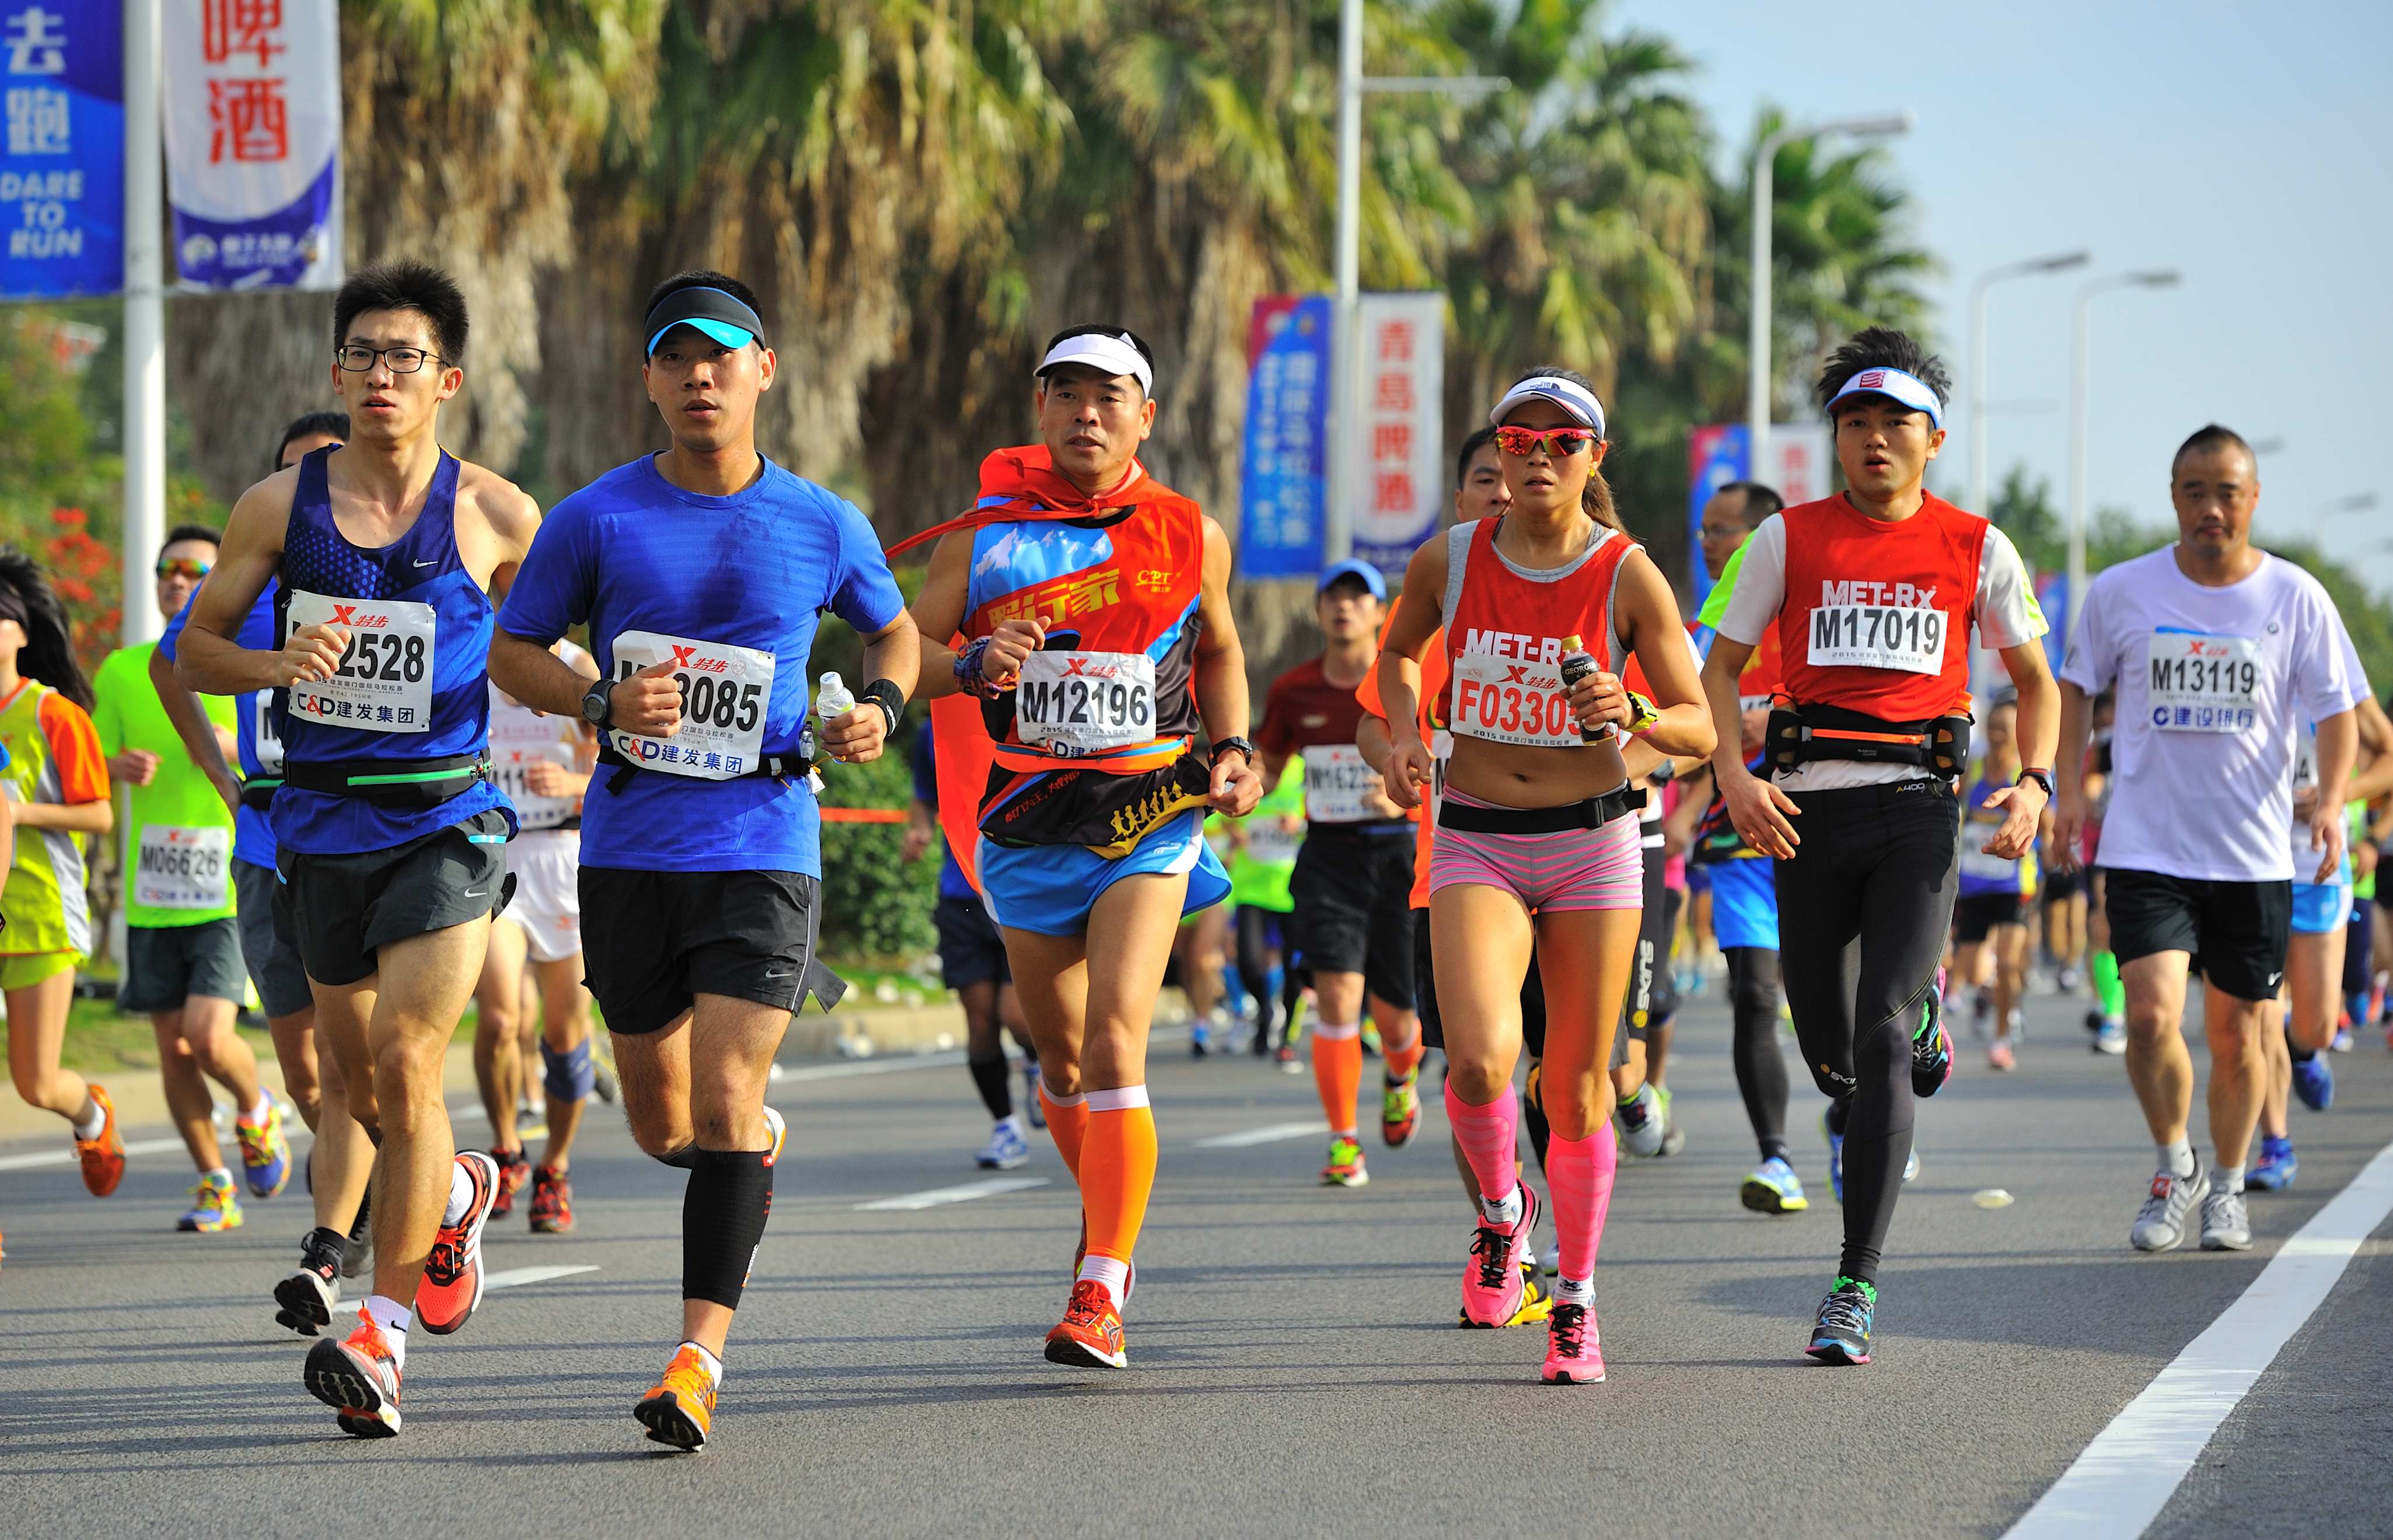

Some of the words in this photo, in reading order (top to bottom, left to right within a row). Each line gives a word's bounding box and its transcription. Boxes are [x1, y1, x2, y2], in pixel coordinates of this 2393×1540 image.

[5, 7, 69, 154] 去跑
[0, 171, 83, 200] DARE
[21, 204, 65, 226] TO
[9, 232, 82, 258] RUN
[1137, 569, 1173, 584] CPT
[1465, 628, 1563, 666] MET-R
[1816, 608, 1940, 655] M17019
[293, 621, 424, 682] 2528
[2153, 658, 2255, 693] M13119
[621, 660, 762, 732] 8085
[1022, 681, 1148, 726] M12196
[682, 725, 733, 740] 门国际马拉松赛
[1473, 729, 1496, 739] 2015
